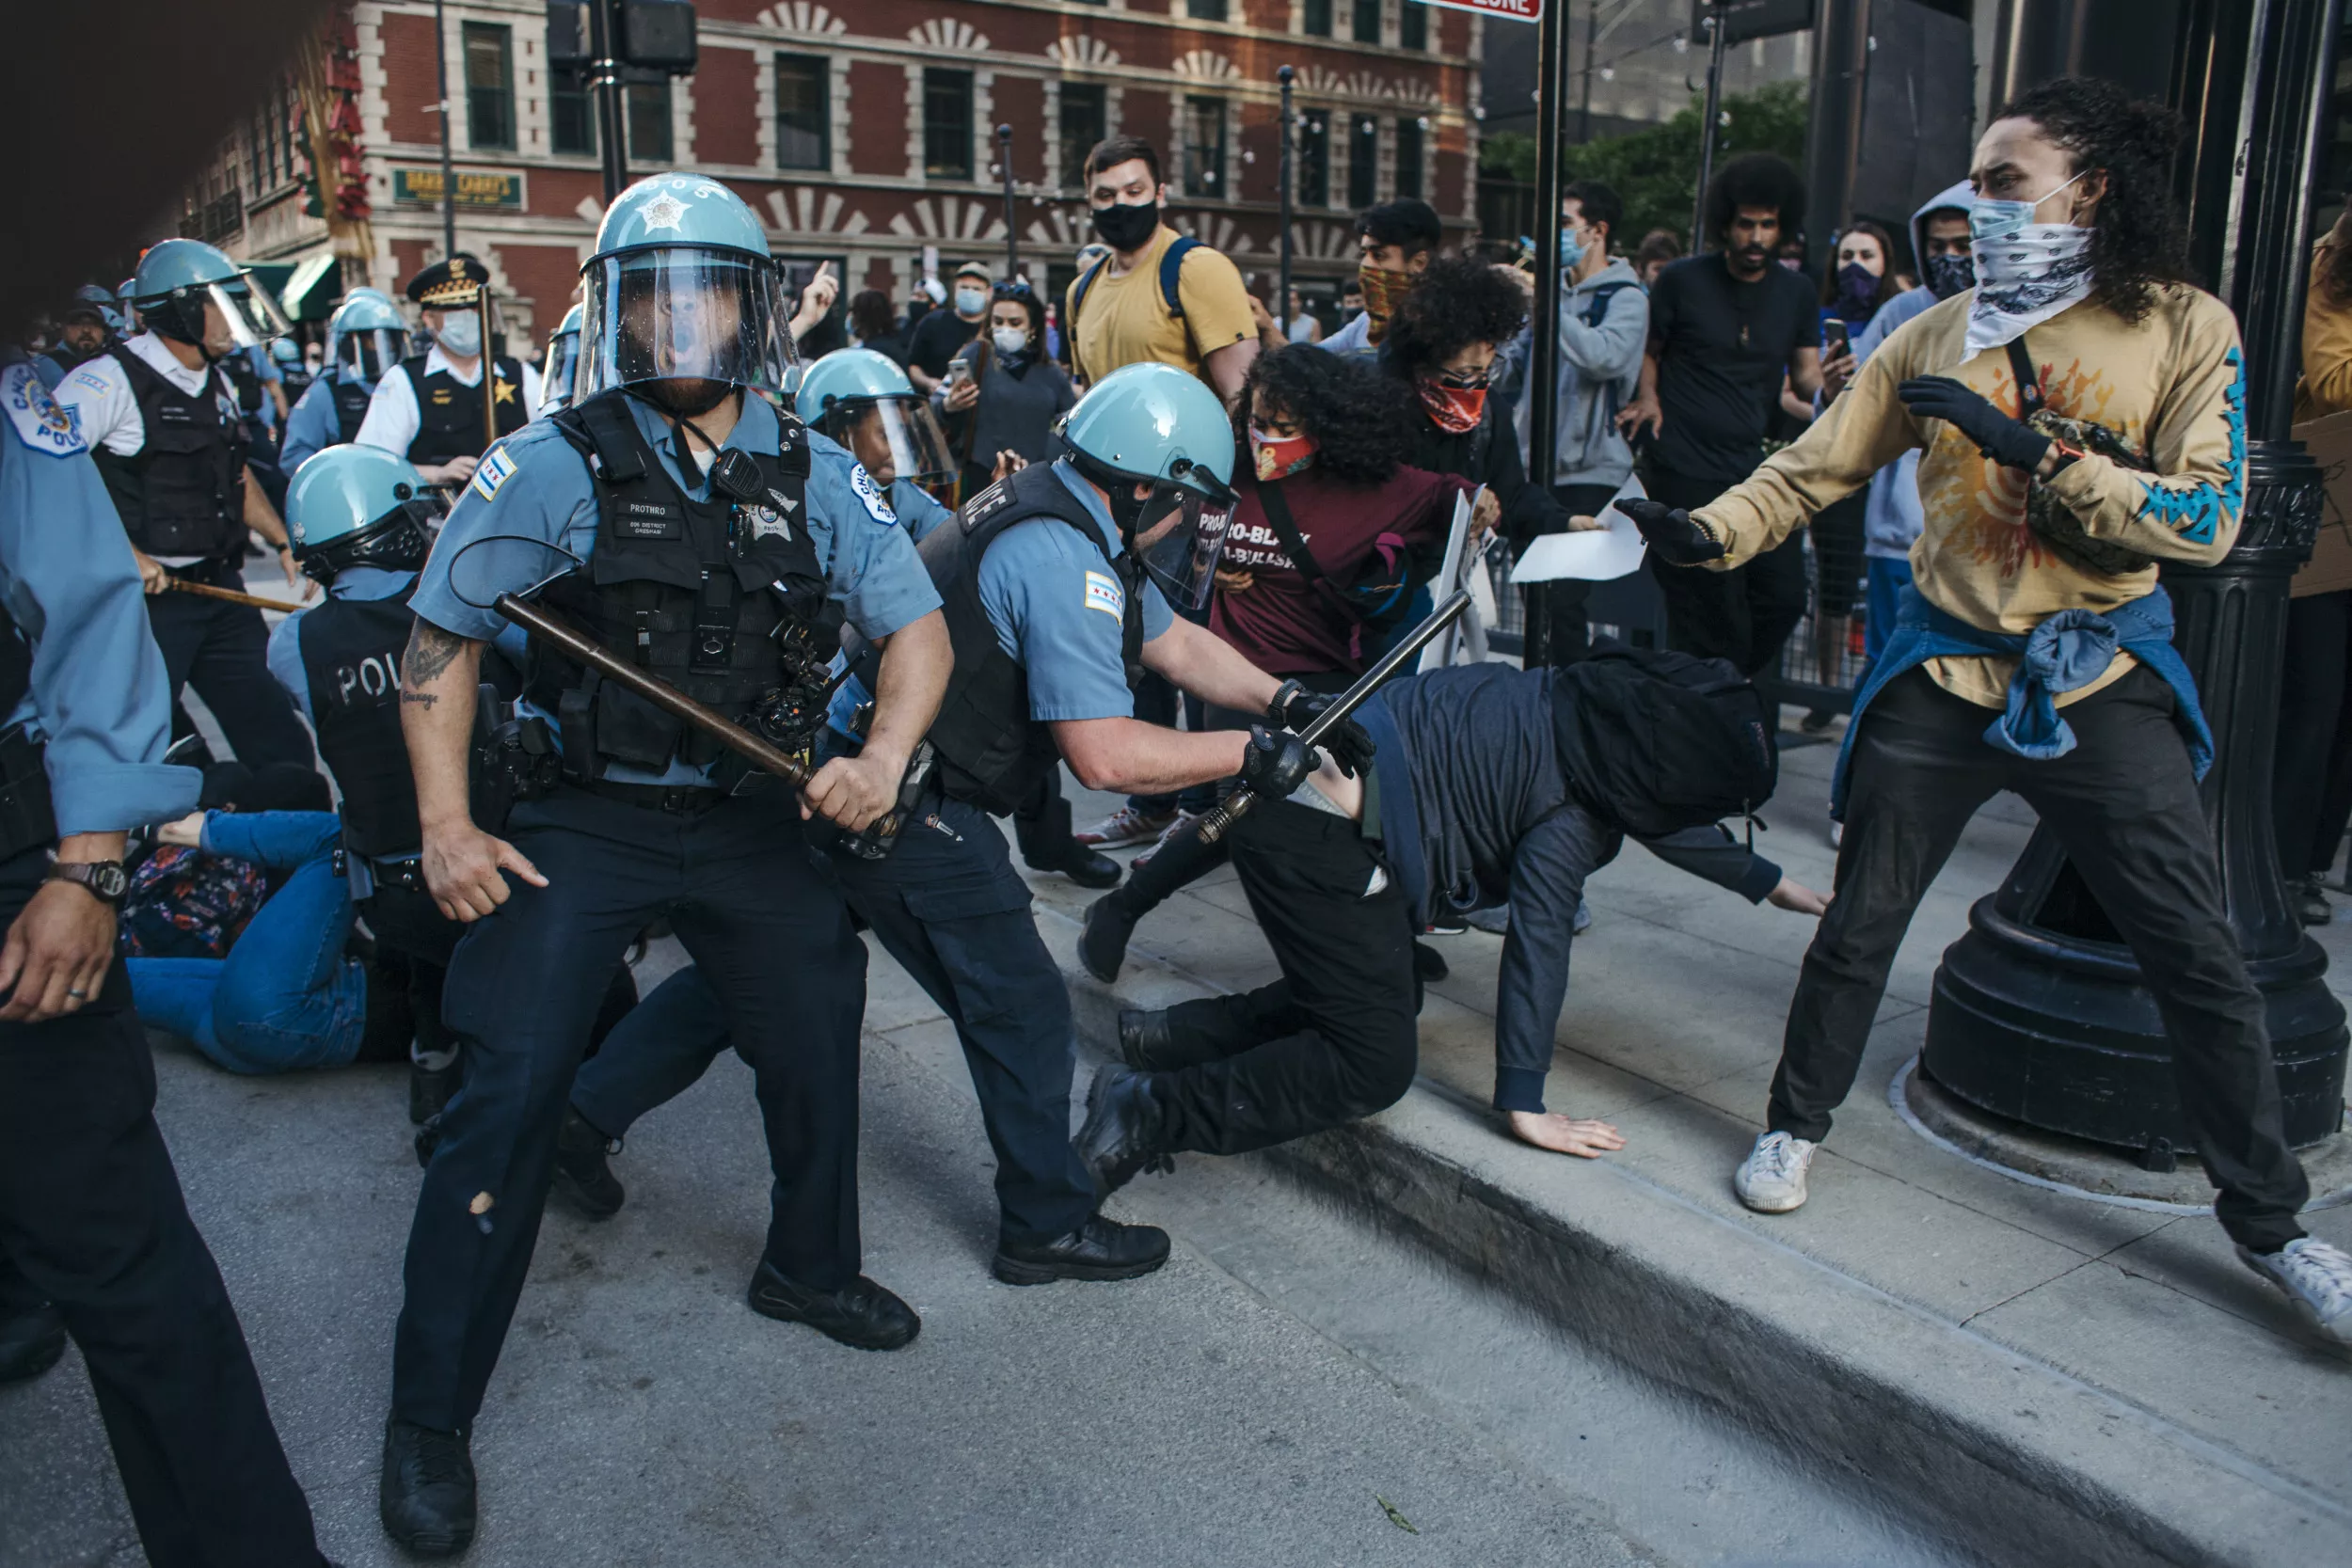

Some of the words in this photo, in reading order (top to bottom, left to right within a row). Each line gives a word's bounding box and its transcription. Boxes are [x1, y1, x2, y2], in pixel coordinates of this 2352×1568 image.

[1472, 0, 1532, 13] NE
[856, 467, 870, 495] CHIC
[630, 503, 666, 515] PROTHRO
[965, 477, 1007, 527] LICE
[337, 652, 402, 705] POL
